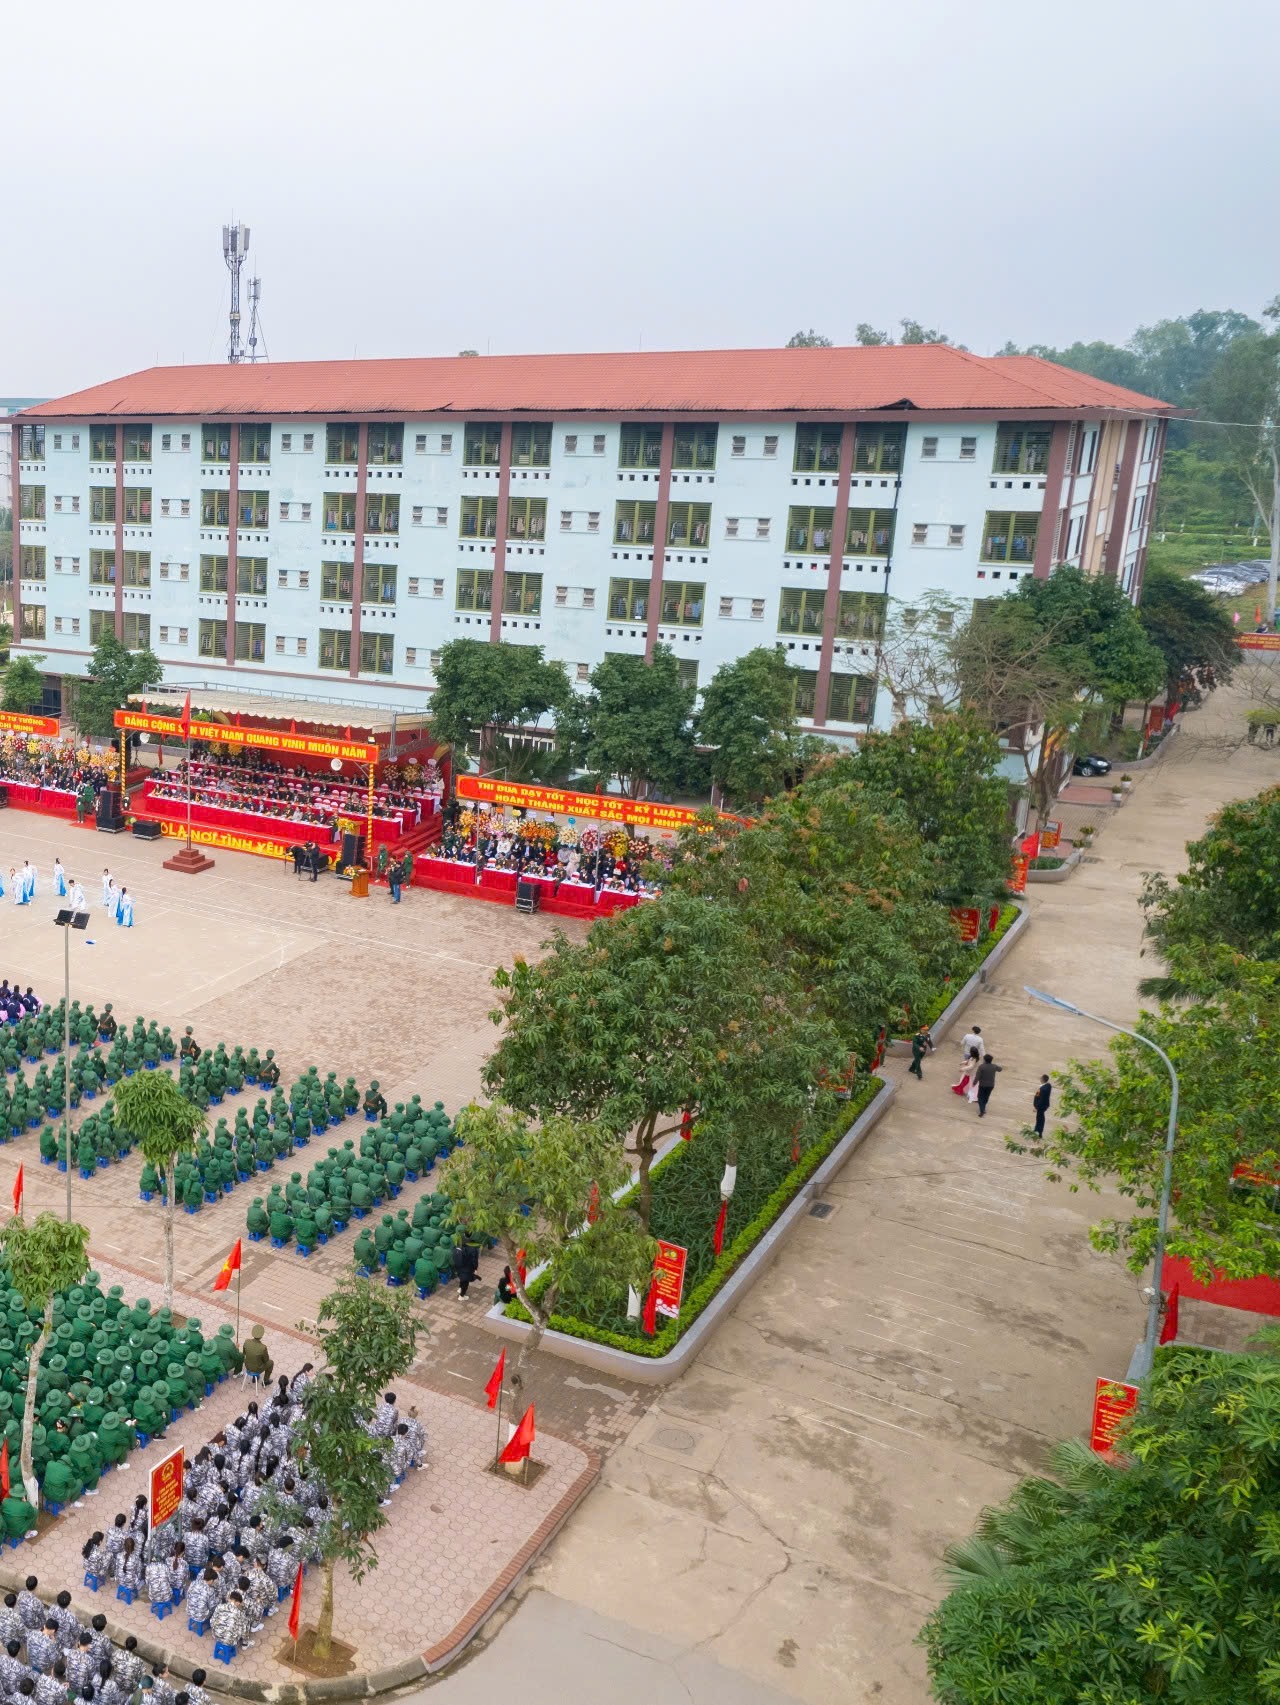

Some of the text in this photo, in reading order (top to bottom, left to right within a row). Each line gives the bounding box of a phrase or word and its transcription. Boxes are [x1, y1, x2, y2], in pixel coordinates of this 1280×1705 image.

[13, 724, 34, 732] MINH
[124, 714, 367, 759] ĐẢNG CỘNG SN VIỆT NAM QUANG VINH MUÔN NĂM
[477, 781, 494, 790] THI
[497, 784, 518, 794] ĐUA
[521, 788, 542, 798] DẠY
[545, 791, 566, 801] TỐT
[575, 796, 599, 807] HỌC
[602, 800, 624, 810] TỐT
[653, 806, 683, 819] LUẬT
[495, 793, 525, 805] HOÀN
[528, 798, 565, 811] THÀNH
[567, 804, 597, 816] XUẤT
[600, 808, 623, 820] SẮC
[626, 814, 650, 825] MỌI
[191, 828, 218, 843] NƠI
[220, 833, 252, 850] TÌNH
[257, 841, 284, 856] YÊU
